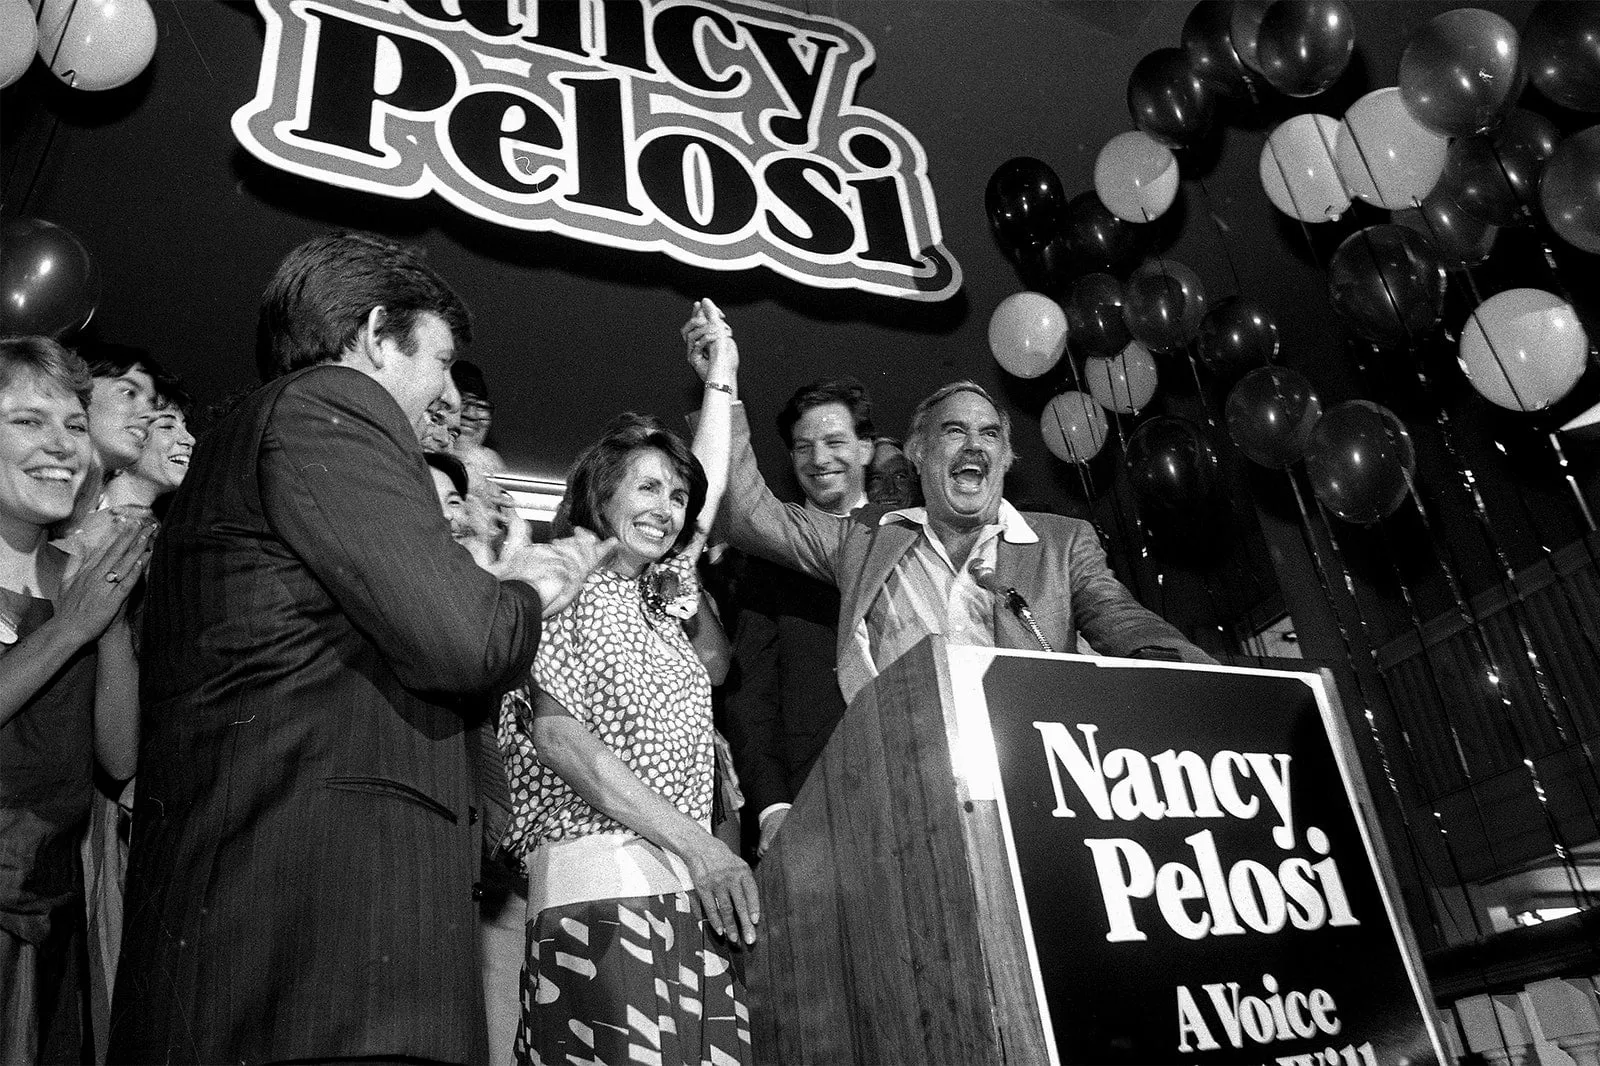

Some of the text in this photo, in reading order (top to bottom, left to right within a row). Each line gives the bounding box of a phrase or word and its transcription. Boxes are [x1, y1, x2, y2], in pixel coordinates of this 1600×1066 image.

[400, 0, 841, 147] ncy
[289, 8, 930, 269] Pelosi
[1033, 721, 1294, 849] Nancy
[1084, 827, 1361, 943] Pelosi
[1177, 973, 1342, 1052] A Voice
